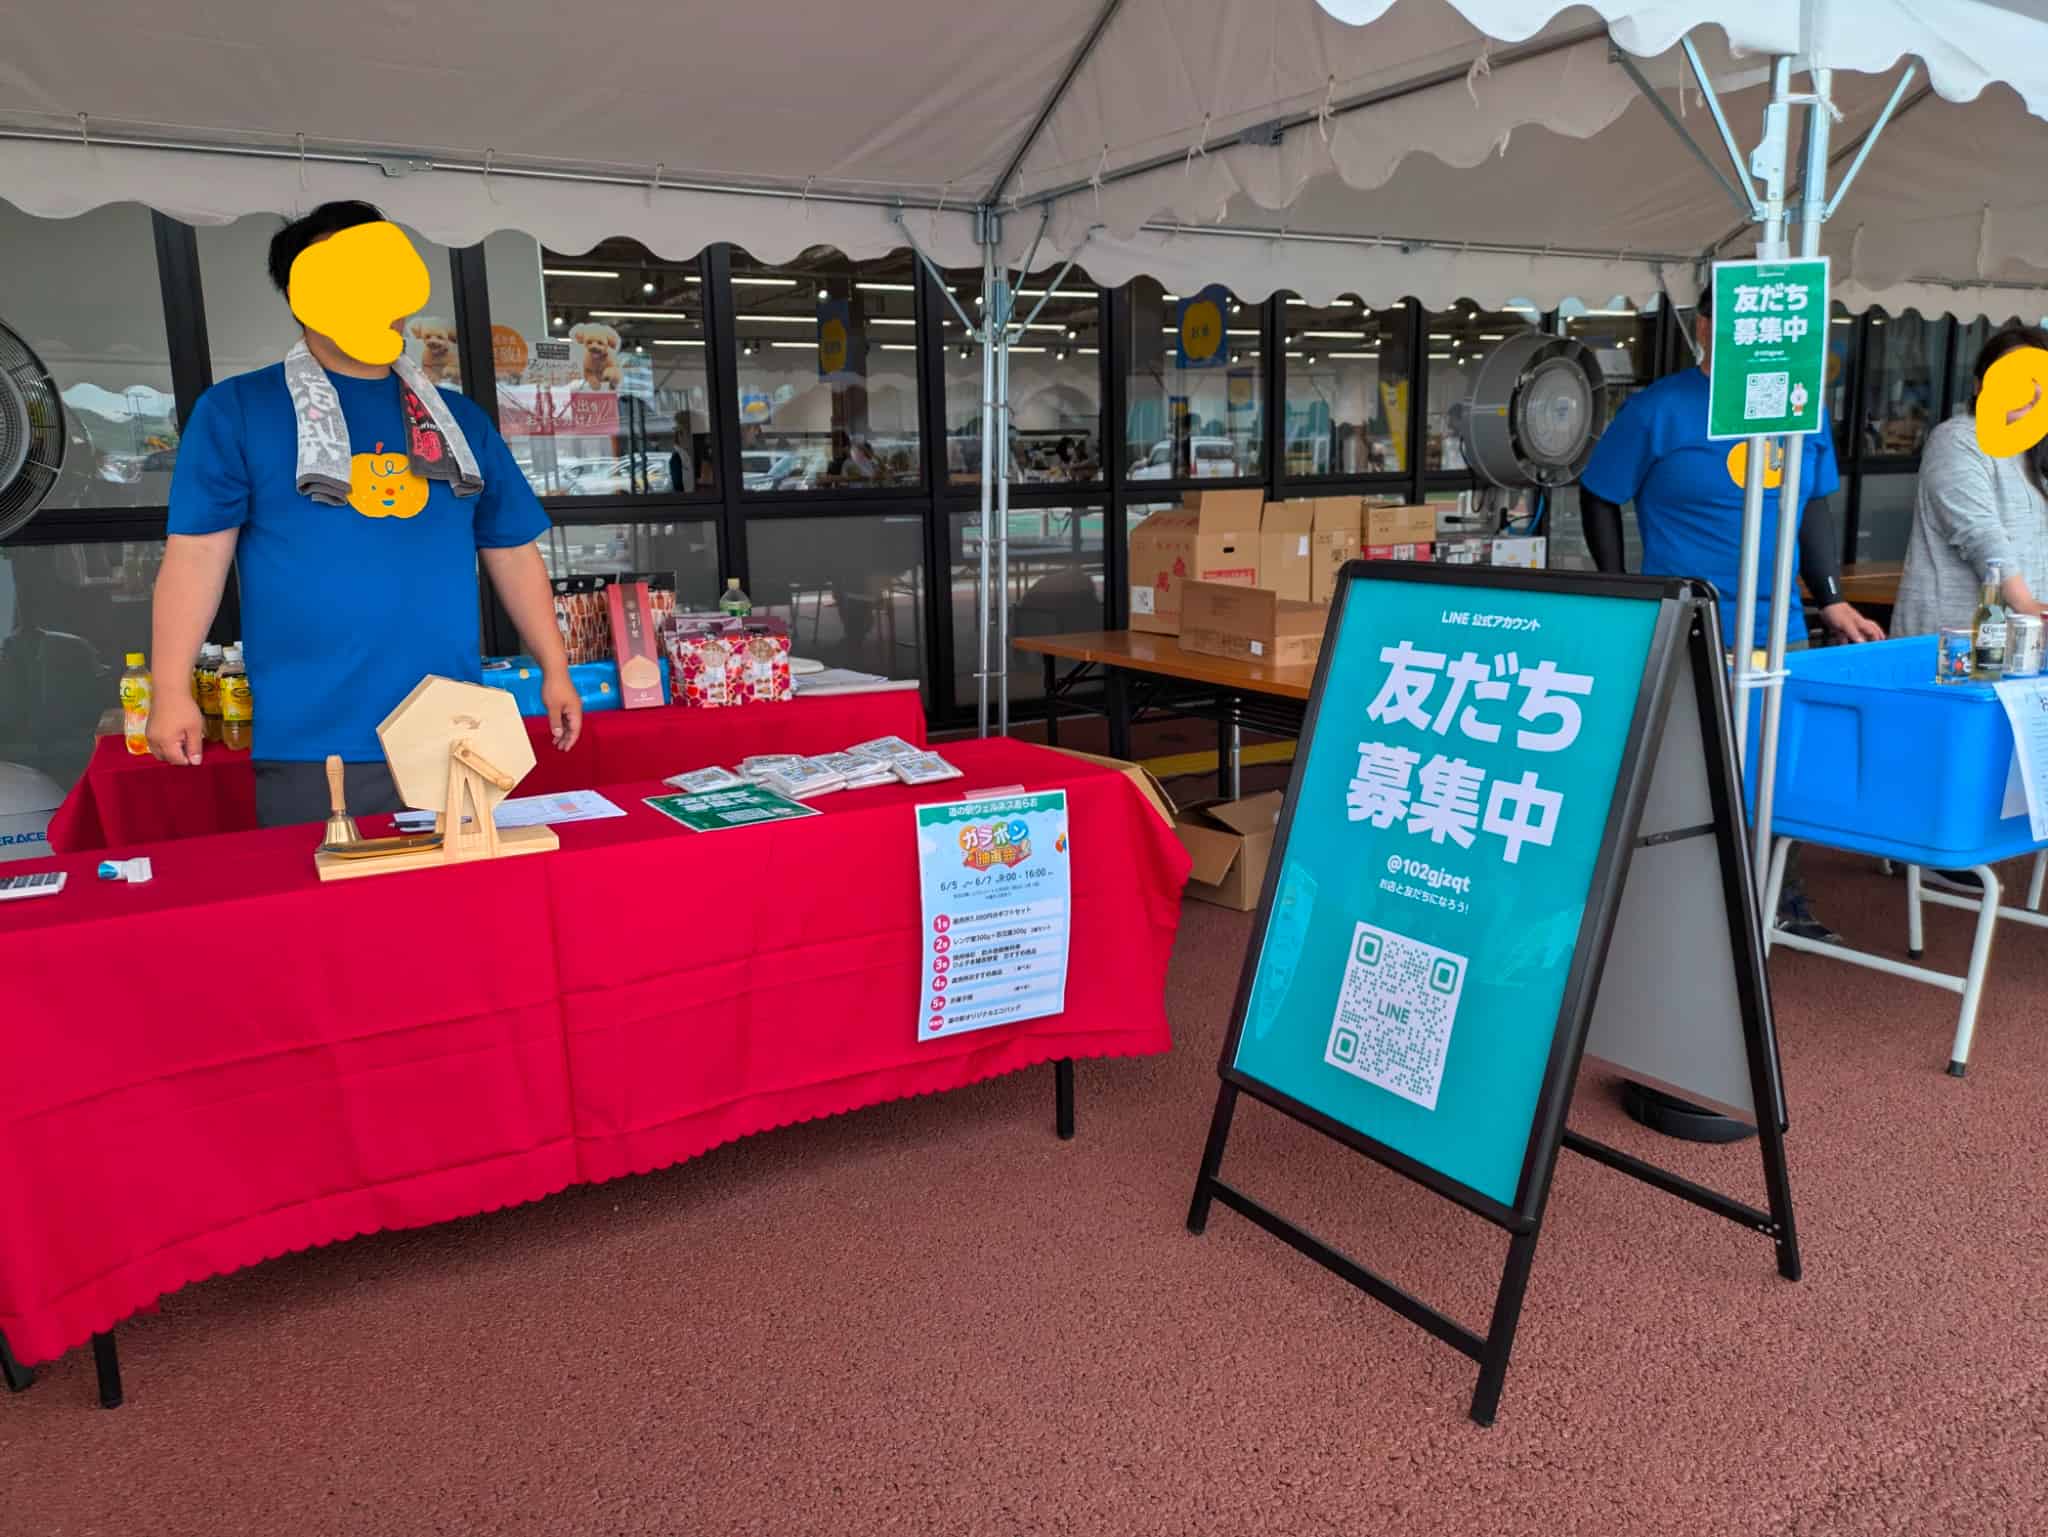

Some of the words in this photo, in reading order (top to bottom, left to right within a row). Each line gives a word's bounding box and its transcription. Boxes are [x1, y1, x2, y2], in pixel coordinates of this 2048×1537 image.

[1734, 283, 1808, 312] 友だち
[1734, 316, 1808, 345] 募集中
[1441, 610, 1470, 625] LINE
[1471, 613, 1541, 631] 公式アカウント
[1366, 640, 1594, 752] 友だち
[1346, 741, 1564, 864] 募集中
[1387, 854, 1471, 894] @102gjzqt
[1377, 999, 1410, 1025] LINE
